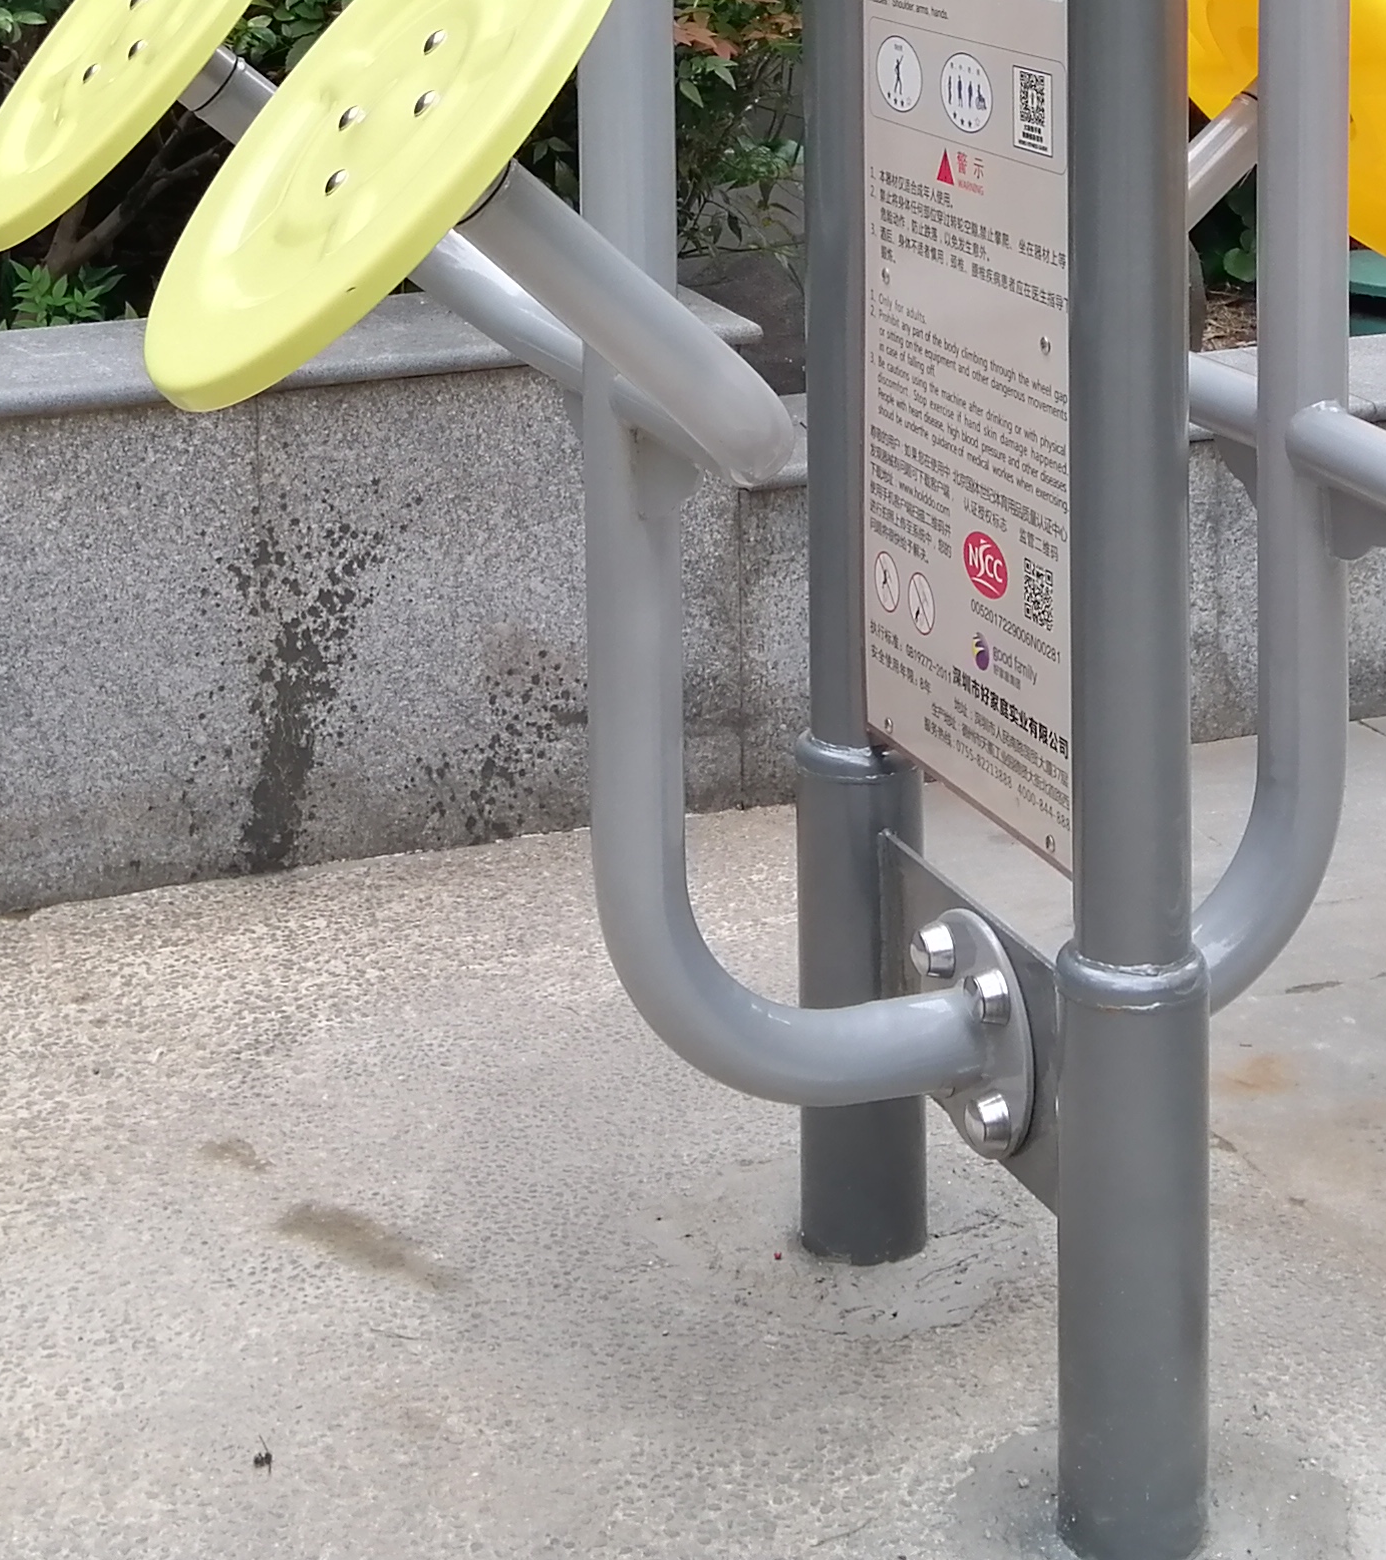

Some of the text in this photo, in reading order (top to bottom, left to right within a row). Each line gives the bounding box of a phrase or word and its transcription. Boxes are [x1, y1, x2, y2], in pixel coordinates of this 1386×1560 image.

[957, 151, 984, 181] 警示
[870, 289, 876, 301] 1.
[895, 300, 903, 313] for
[870, 305, 876, 317] 2.
[901, 321, 911, 335] any
[912, 325, 923, 341] part
[924, 329, 932, 342] of
[932, 333, 943, 348] the
[944, 338, 959, 358] body
[961, 346, 988, 371] climbing
[990, 359, 1016, 383] through
[1018, 371, 1030, 387] the
[1031, 377, 1052, 397] wheel
[1054, 390, 1068, 407] gap
[879, 326, 885, 336] or
[905, 338, 913, 349] on
[914, 341, 923, 354] the
[924, 346, 957, 373] equipment
[958, 361, 970, 376] and
[972, 368, 989, 385] other
[991, 377, 1025, 406] dangerous
[1027, 394, 1068, 422] movements
[886, 346, 898, 358] case
[899, 350, 906, 362] of
[870, 353, 876, 364] 3.
[878, 356, 885, 368] Be
[929, 381, 939, 395] the
[941, 386, 966, 409] machine
[968, 400, 984, 417] after
[985, 408, 1013, 434] drinking
[1014, 425, 1022, 436] or
[1024, 426, 1038, 443] with
[1040, 433, 1066, 460] physical
[908, 403, 923, 420] heart
[947, 422, 960, 442] high
[961, 429, 979, 448] blood
[982, 442, 1006, 465] pressure
[1008, 454, 1020, 469] and
[1021, 460, 1039, 479] other
[913, 389, 928, 409] Stop
[930, 398, 955, 420] exercise
[957, 411, 962, 423] if
[964, 414, 981, 433] hand
[983, 423, 997, 441] skin
[1000, 432, 1028, 458] damage
[1031, 447, 1069, 479] happened.
[896, 413, 903, 425] be
[931, 430, 958, 458] guidance
[958, 444, 965, 458] of
[967, 448, 990, 471] medical
[1016, 474, 1034, 494] when
[968, 539, 1002, 583] NSCC
[992, 644, 1038, 686] good family
[952, 664, 1069, 761] 深圳市好家庭实业有限公司
